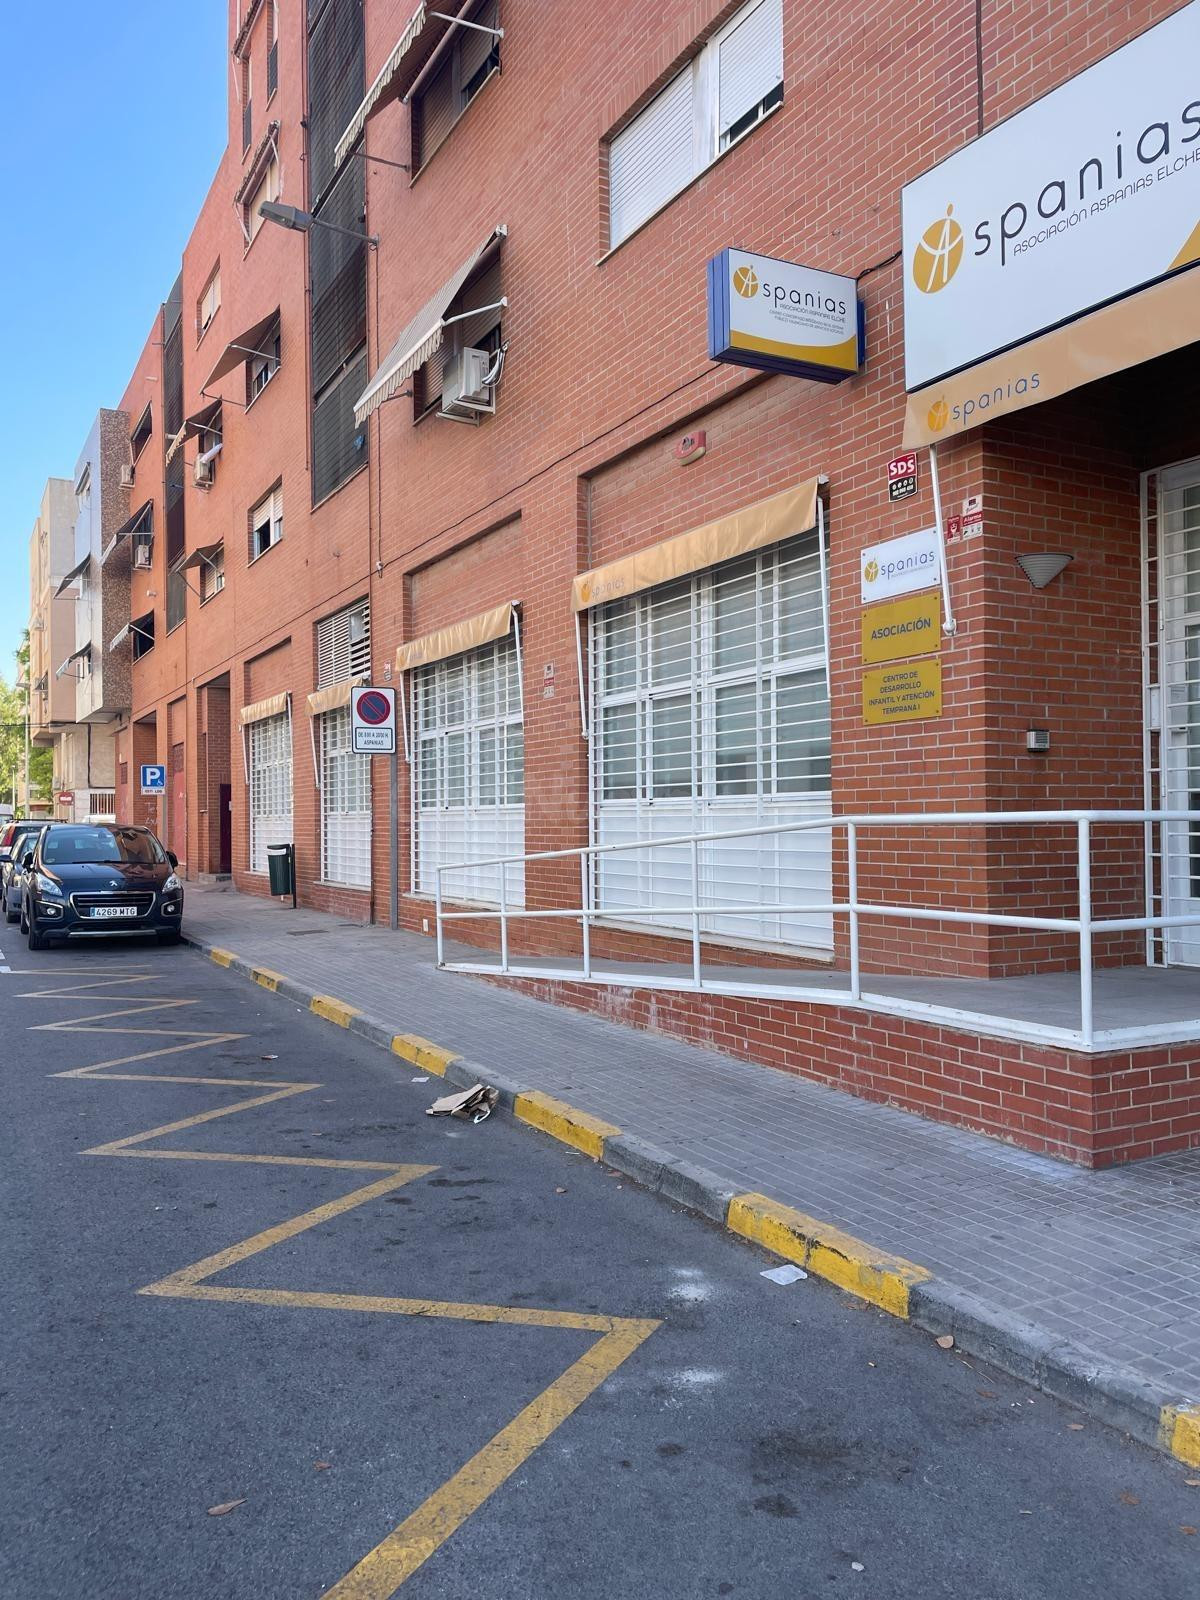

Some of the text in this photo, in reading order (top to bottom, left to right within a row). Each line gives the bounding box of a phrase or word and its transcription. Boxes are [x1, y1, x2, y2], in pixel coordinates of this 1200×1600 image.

[1013, 208, 1087, 257] ASOCIACIÓN
[1090, 173, 1153, 216] ASPANIAS
[889, 459, 915, 476] SDS
[871, 617, 931, 640] ASOCIACIÓN
[883, 671, 918, 683] CENTRO DE
[880, 681, 921, 694] DESARROLLO
[869, 697, 895, 706] INFANTIL
[882, 704, 917, 715] TEMPRANA
[146, 767, 160, 786] P
[96, 908, 117, 916] 4269
